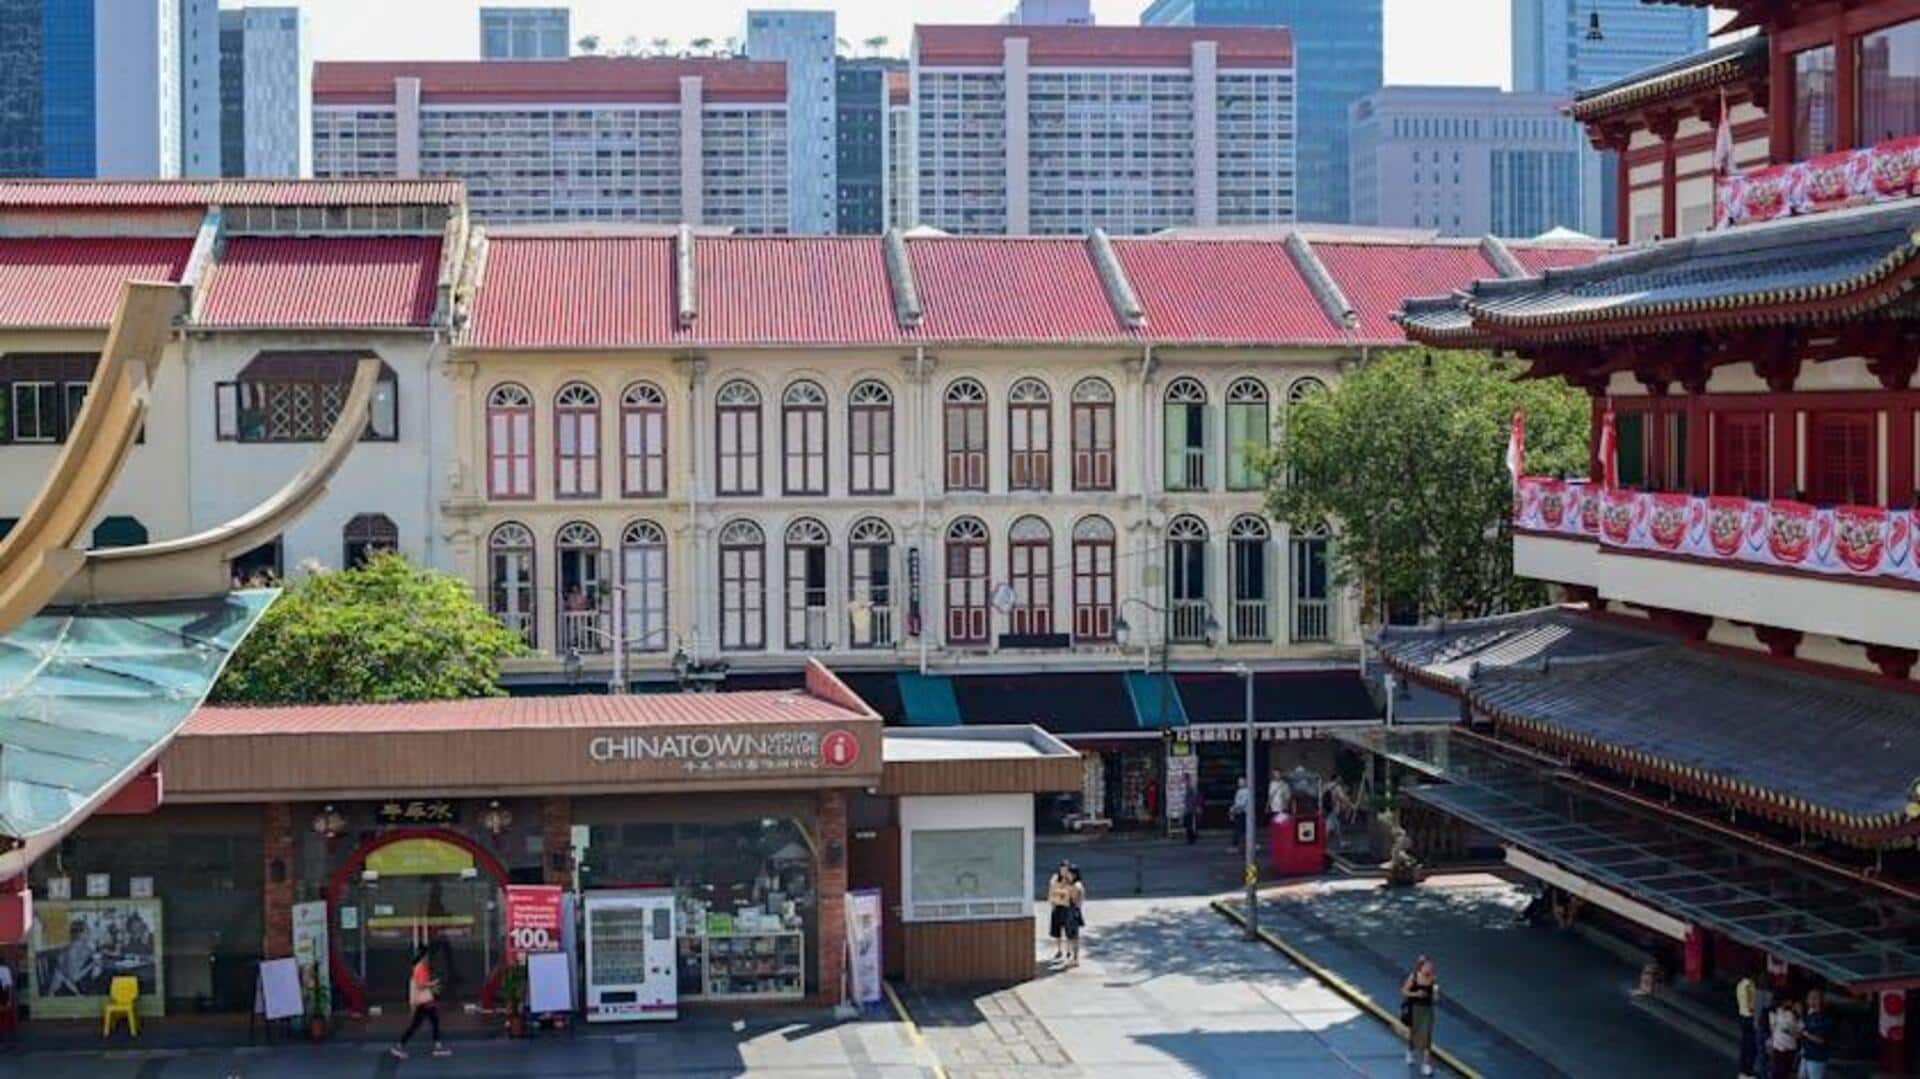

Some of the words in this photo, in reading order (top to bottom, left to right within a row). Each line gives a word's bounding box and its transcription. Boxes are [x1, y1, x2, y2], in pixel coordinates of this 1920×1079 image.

[590, 733, 767, 760] CHINATOWN
[768, 743, 819, 757] CENTRE
[510, 928, 549, 949] 100
